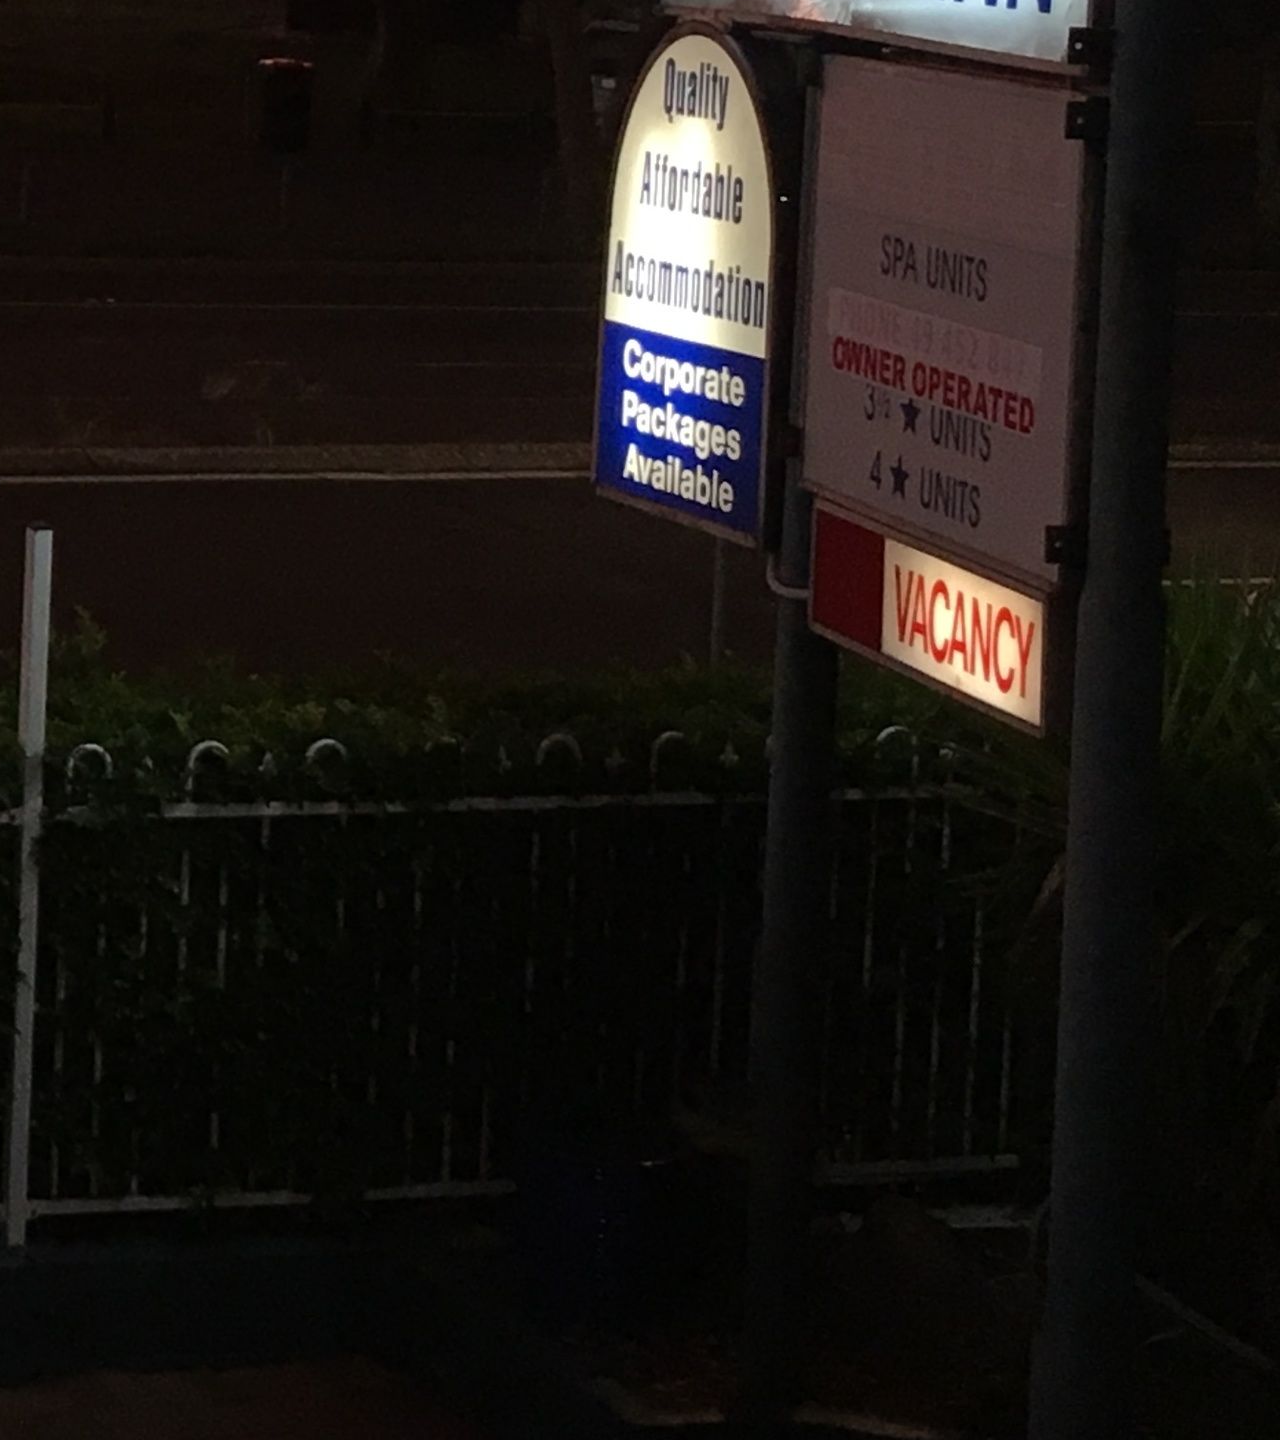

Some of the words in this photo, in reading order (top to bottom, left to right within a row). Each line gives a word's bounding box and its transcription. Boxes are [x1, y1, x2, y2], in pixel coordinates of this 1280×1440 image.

[663, 57, 729, 131] Quality
[639, 151, 743, 224] Affordable
[611, 240, 765, 329] Accommodation
[880, 234, 918, 283] SPA
[926, 246, 988, 302] UNITS
[622, 338, 746, 408] Corporate
[832, 336, 907, 392] OWNER
[911, 361, 1035, 434] OPERATED
[621, 391, 741, 461] Packages
[929, 405, 992, 462] UNITS
[622, 444, 735, 513] Available
[869, 450, 882, 491] 4
[919, 465, 981, 528] UNITS
[894, 564, 1036, 699] VACANCY
